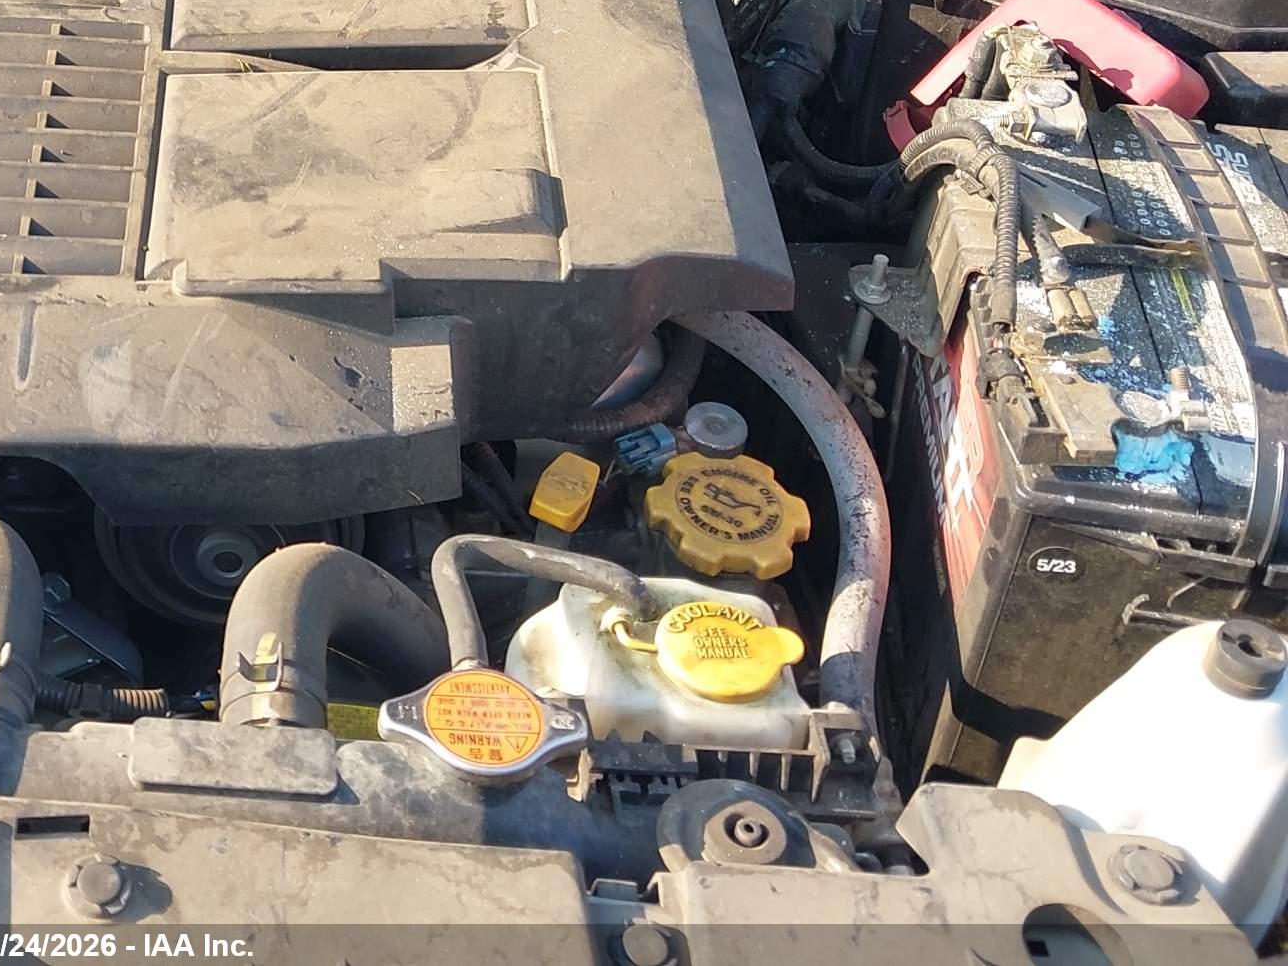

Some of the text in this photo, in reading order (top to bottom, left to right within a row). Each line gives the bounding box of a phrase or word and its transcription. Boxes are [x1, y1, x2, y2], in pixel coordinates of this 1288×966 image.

[1230, 153, 1263, 206] SUPER
[760, 488, 777, 506] OIL
[680, 475, 780, 541] SEE OWNER'S MANUAL
[1035, 558, 1077, 574] 5/23
[666, 604, 763, 633] COOLANT
[698, 627, 727, 638] SEE
[694, 636, 747, 648] OWNERS
[696, 647, 750, 659] MANUAL
[449, 732, 502, 747] WARNING
